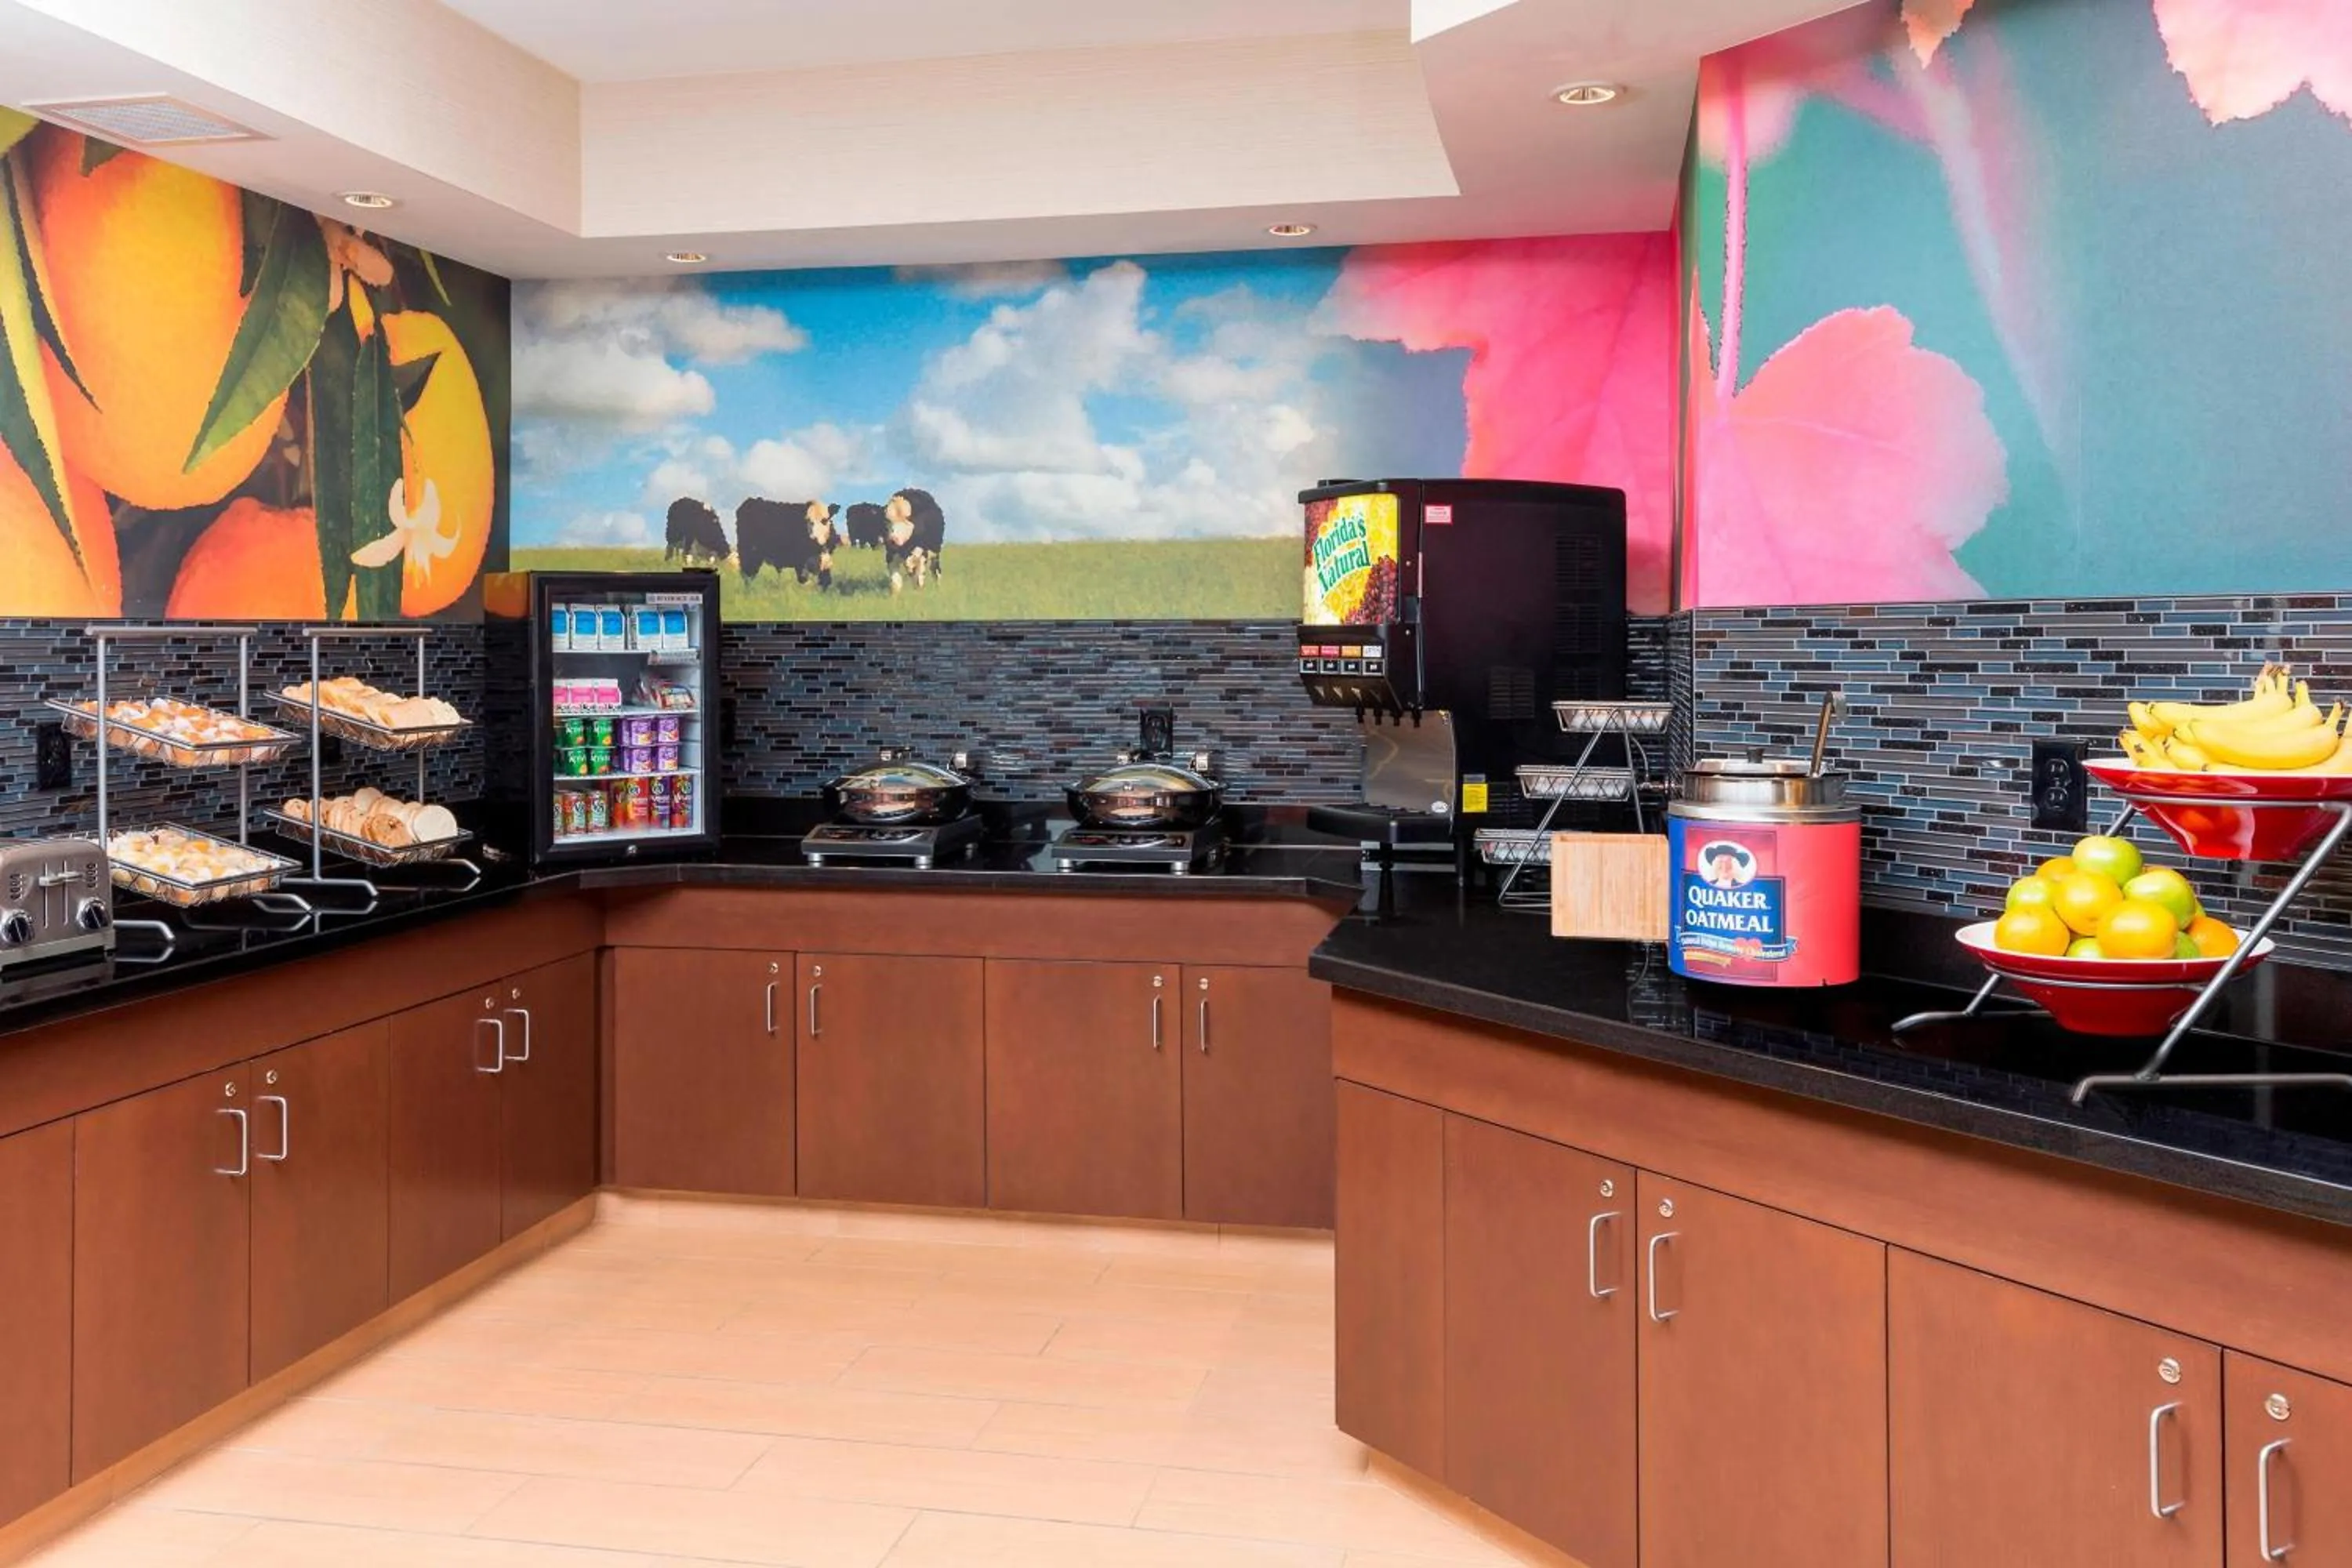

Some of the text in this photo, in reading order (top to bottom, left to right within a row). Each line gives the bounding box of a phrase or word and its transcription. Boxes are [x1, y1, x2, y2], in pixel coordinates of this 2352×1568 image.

[1312, 512, 1367, 572] Florida's
[1317, 540, 1371, 599] Natural
[1688, 885, 1769, 909] QUAKER
[1685, 909, 1773, 933] OATMEAL
